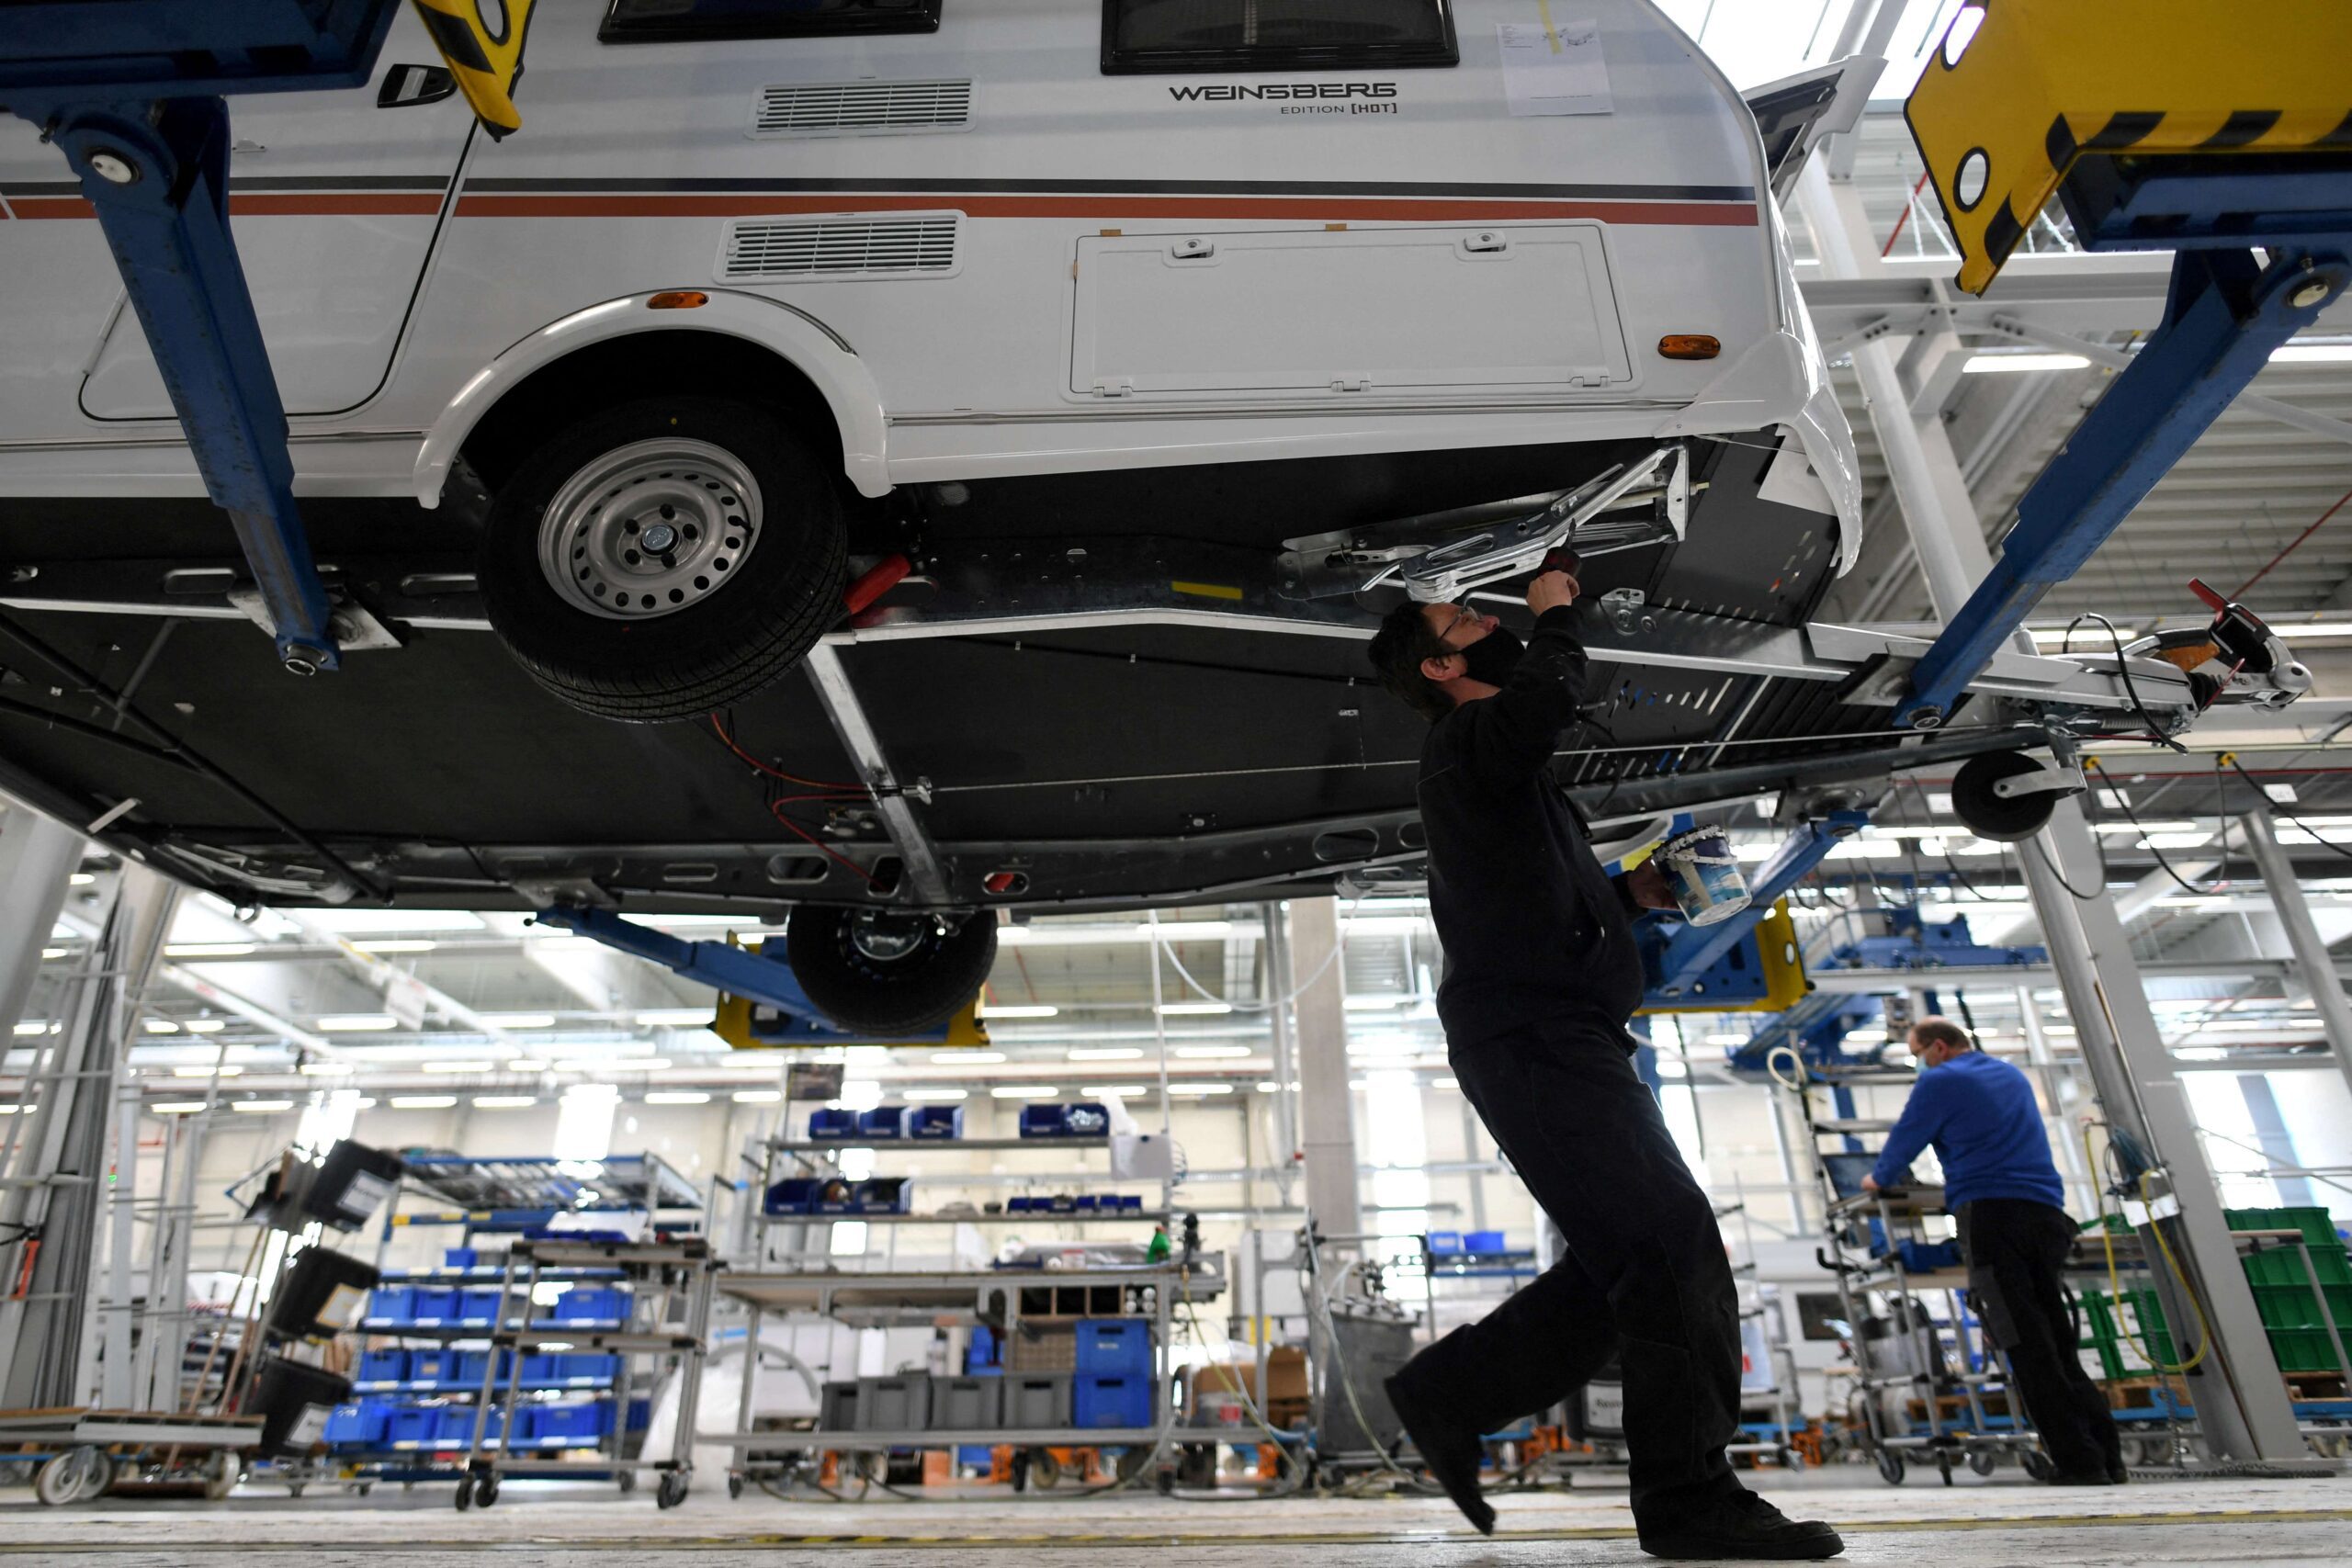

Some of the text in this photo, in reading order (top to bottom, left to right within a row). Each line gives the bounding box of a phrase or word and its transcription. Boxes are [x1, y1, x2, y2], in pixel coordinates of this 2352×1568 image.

[1169, 83, 1397, 101] WEINSBERG
[1281, 103, 1397, 115] EDITION [HOT]
